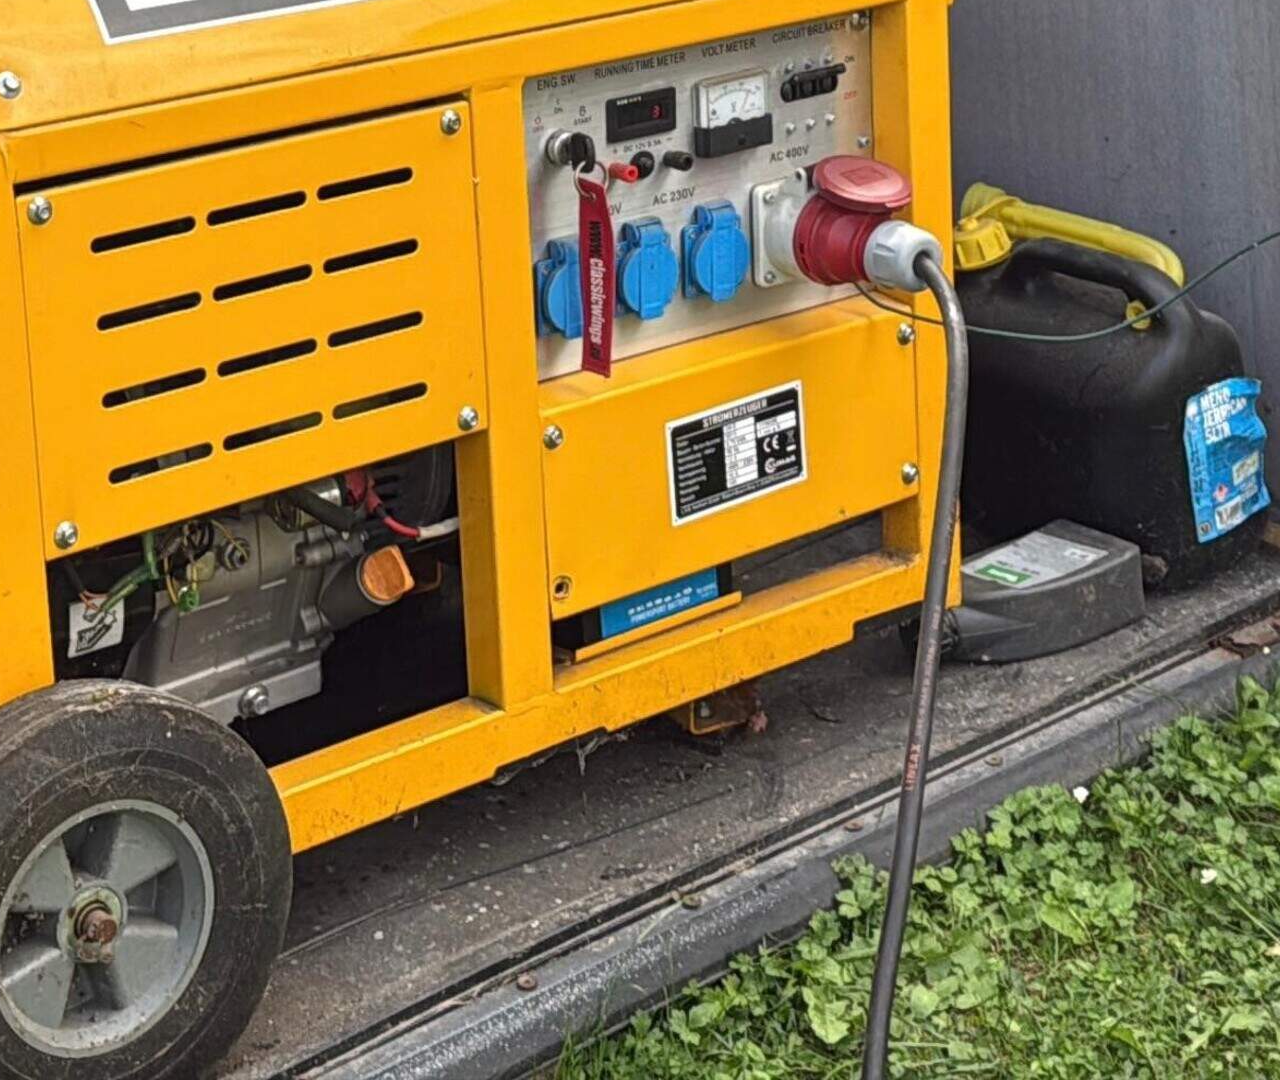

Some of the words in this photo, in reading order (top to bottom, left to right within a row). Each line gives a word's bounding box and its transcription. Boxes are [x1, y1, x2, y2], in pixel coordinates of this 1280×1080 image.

[772, 27, 806, 45] CIRCUIT
[807, 20, 846, 37] BREAKER
[701, 45, 724, 58] VOLT
[725, 38, 757, 54] METER
[594, 62, 635, 80] RUNNING
[636, 57, 656, 73] TIME
[657, 51, 686, 69] METER
[536, 78, 559, 91] ENG
[560, 73, 577, 87] SW
[770, 151, 784, 163] AC
[785, 145, 810, 159] 400V
[652, 193, 669, 207] AC
[669, 186, 696, 204] 230V
